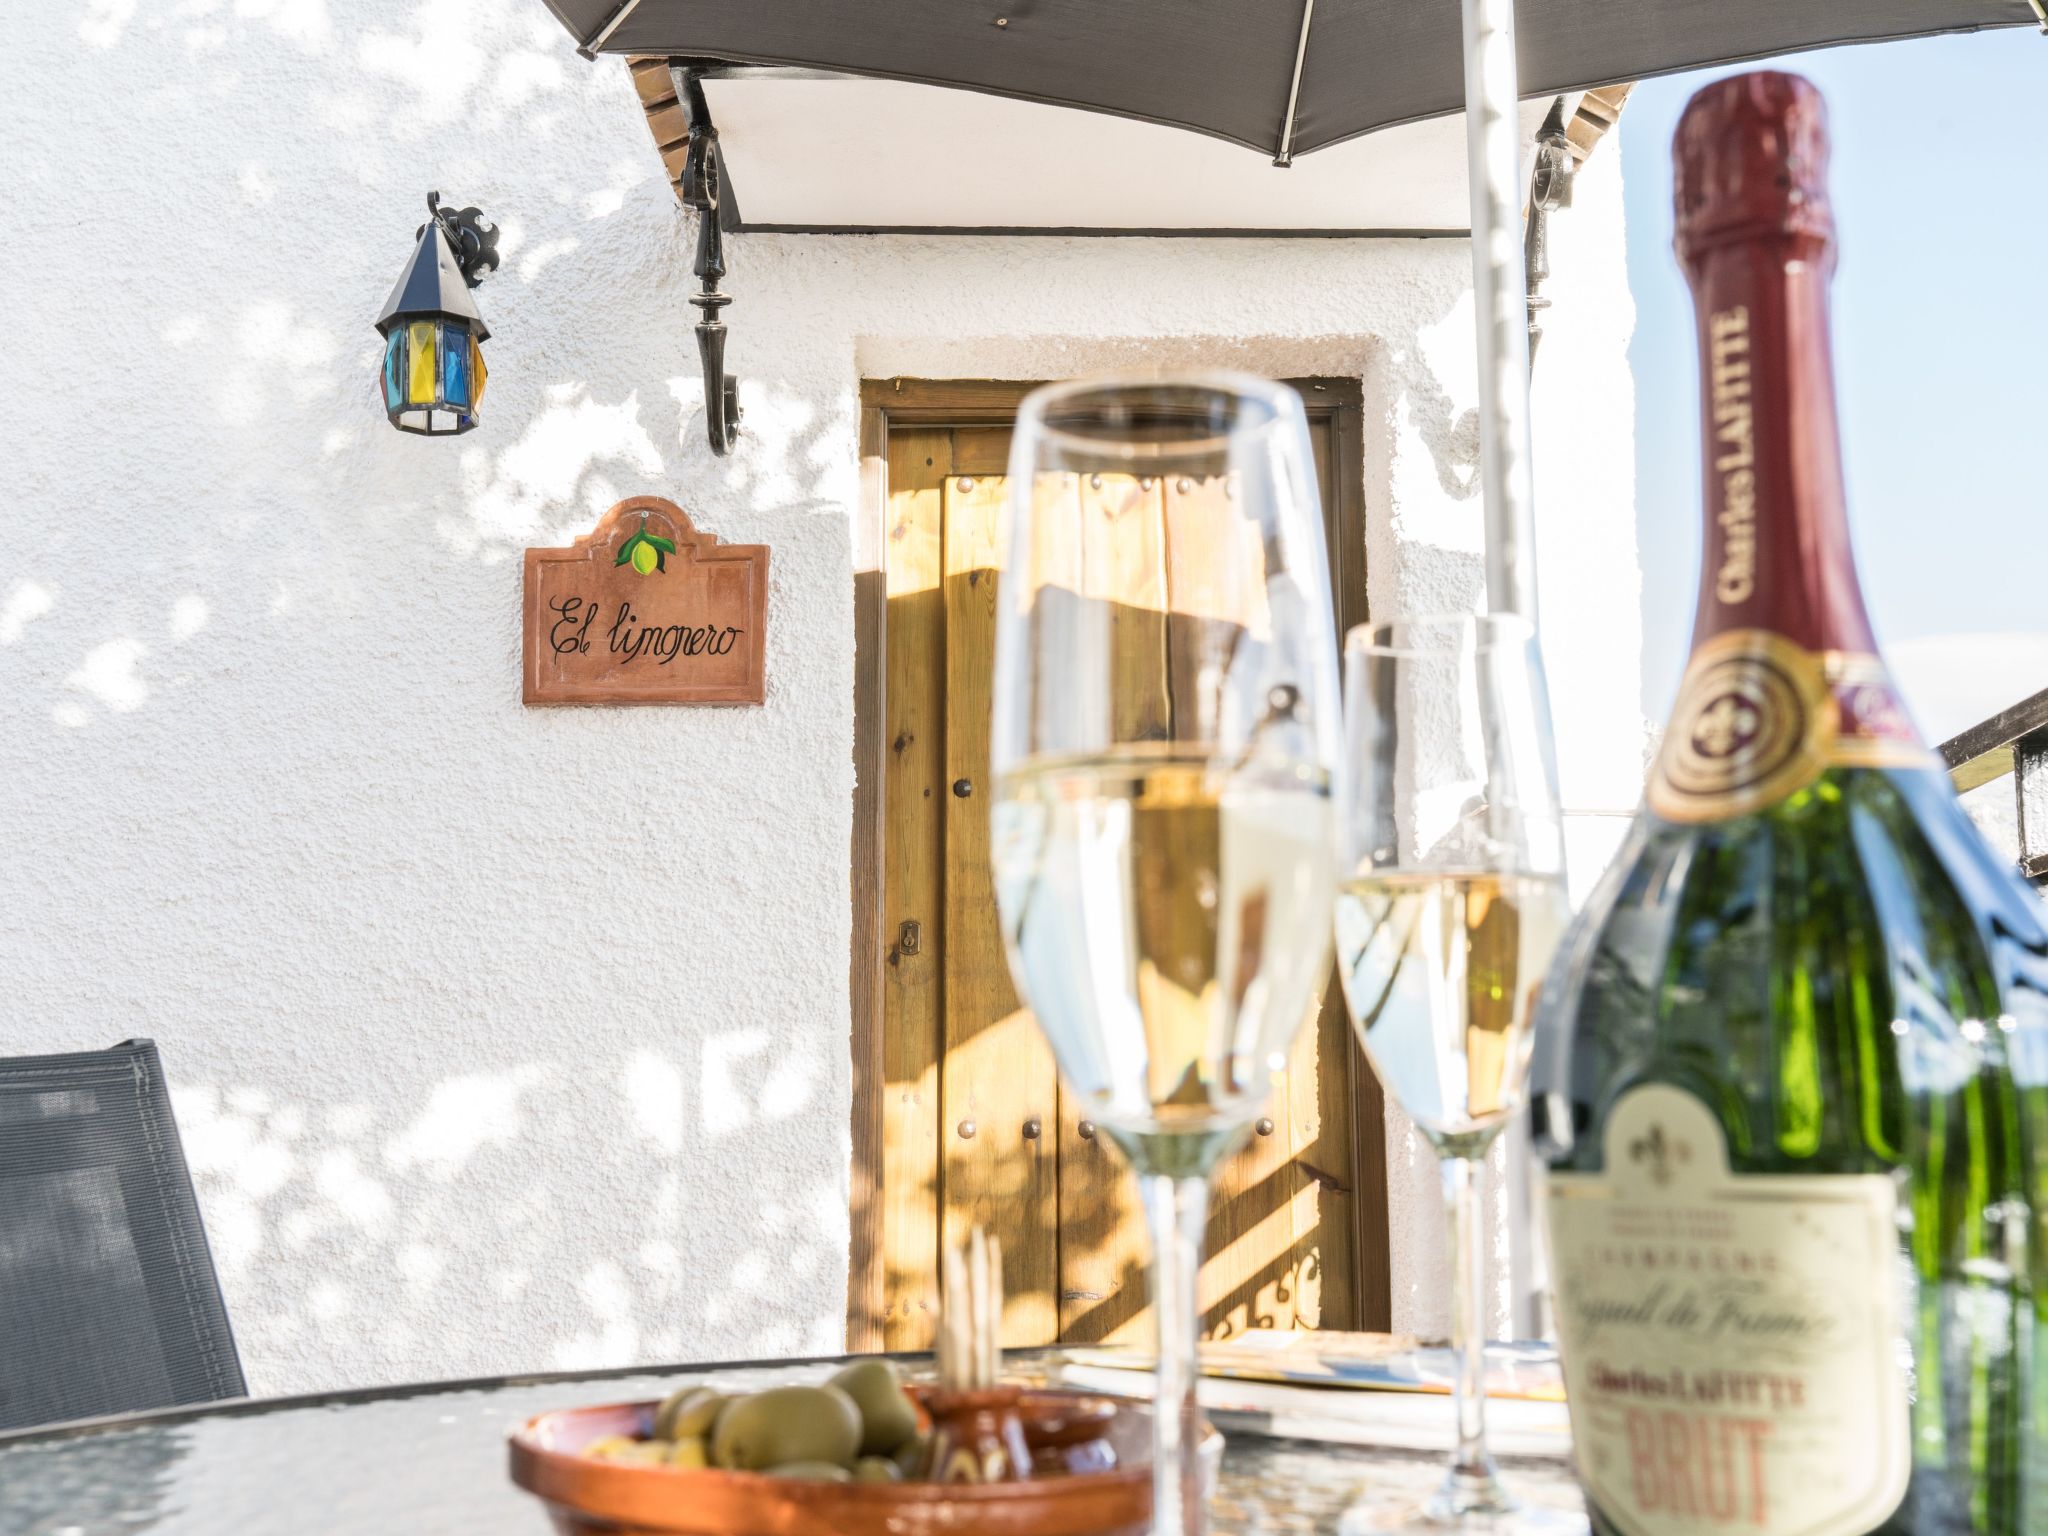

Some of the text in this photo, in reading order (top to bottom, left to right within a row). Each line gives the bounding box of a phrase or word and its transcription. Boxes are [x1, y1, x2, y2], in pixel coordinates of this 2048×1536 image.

[1710, 304, 1756, 605] Charles LAFITTE
[550, 595, 745, 665] El limonero
[1624, 1407, 1776, 1530] BRUT
